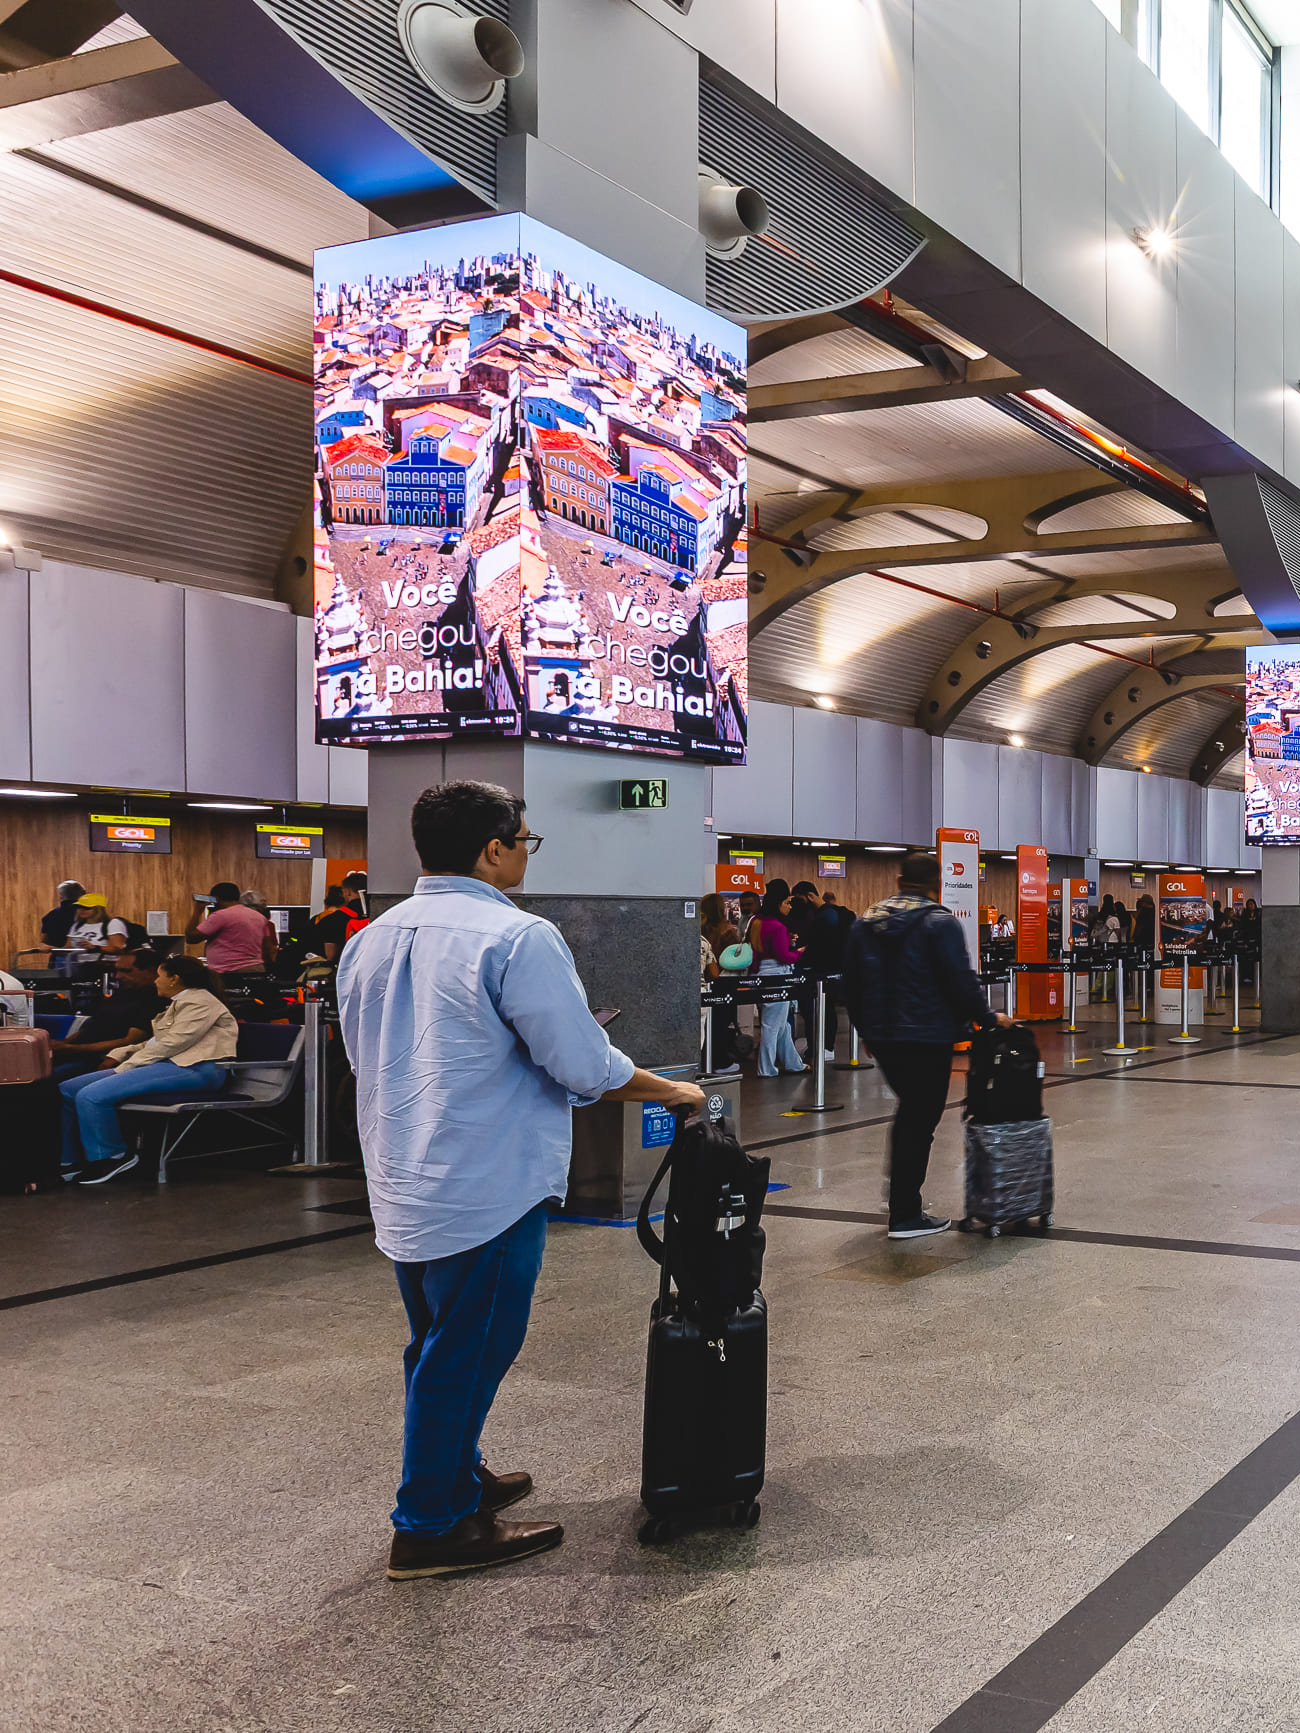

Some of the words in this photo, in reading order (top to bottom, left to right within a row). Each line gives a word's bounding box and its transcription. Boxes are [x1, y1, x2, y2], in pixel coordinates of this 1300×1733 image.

[381, 575, 457, 608] Você
[606, 590, 689, 636] Você
[366, 623, 477, 656] chegou
[588, 632, 708, 679] chegou
[386, 659, 484, 694] Bahia!
[611, 674, 714, 719] Bahia!
[114, 827, 149, 839] GOL
[963, 832, 979, 842] GOL
[276, 836, 305, 847] GOL
[1035, 848, 1047, 857] GOL
[731, 874, 750, 885] GOL
[944, 881, 973, 889] Prioridades
[1166, 882, 1187, 892] GOL
